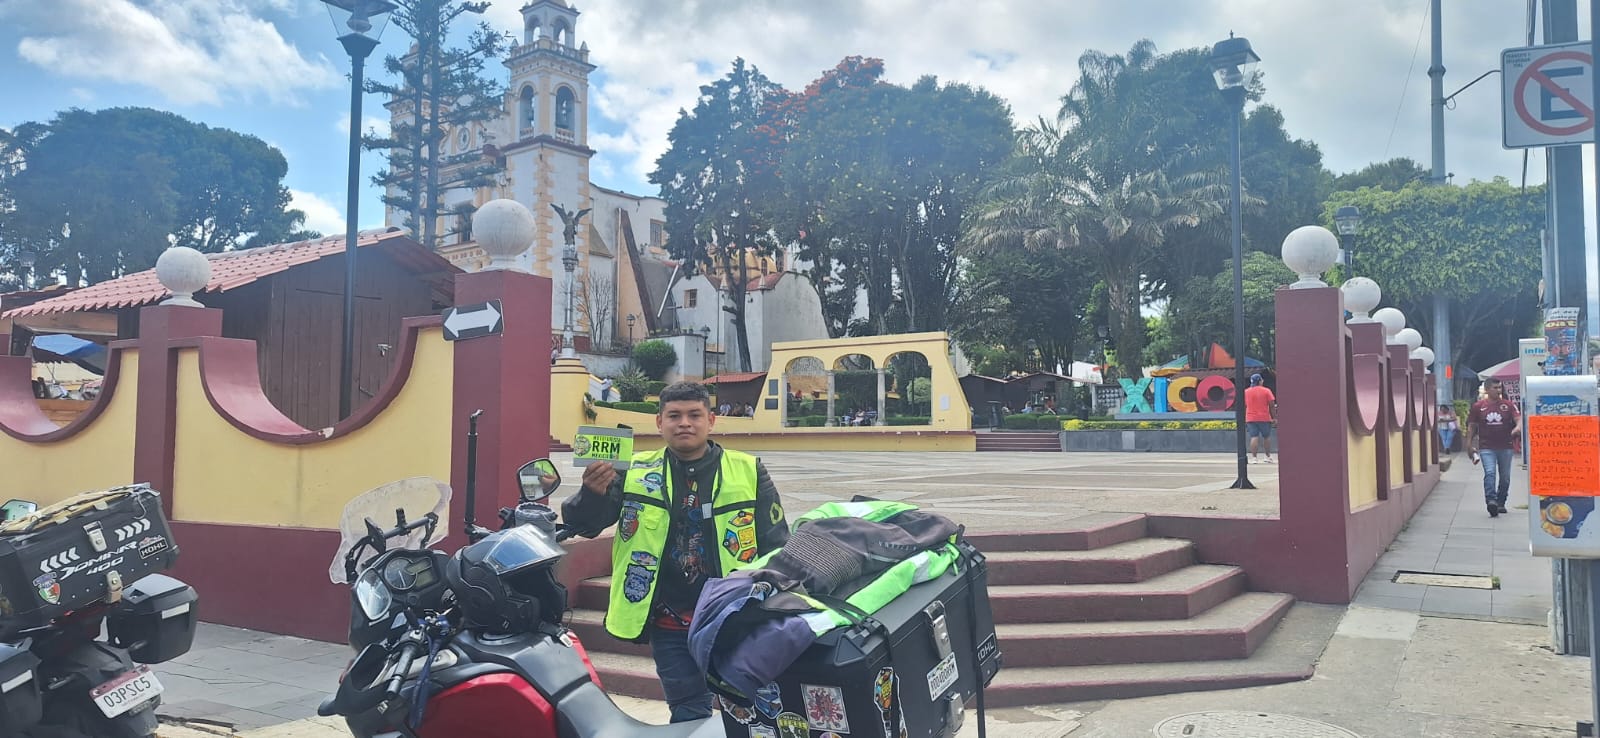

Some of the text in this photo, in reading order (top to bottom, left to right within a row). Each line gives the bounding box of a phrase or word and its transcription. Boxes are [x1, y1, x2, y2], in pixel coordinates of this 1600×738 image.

[1540, 66, 1586, 121] E
[1117, 375, 1236, 413] XICO
[592, 440, 620, 454] RRM
[140, 542, 166, 558] KOHL
[86, 556, 124, 575] 400
[103, 676, 151, 708] 03PSC5
